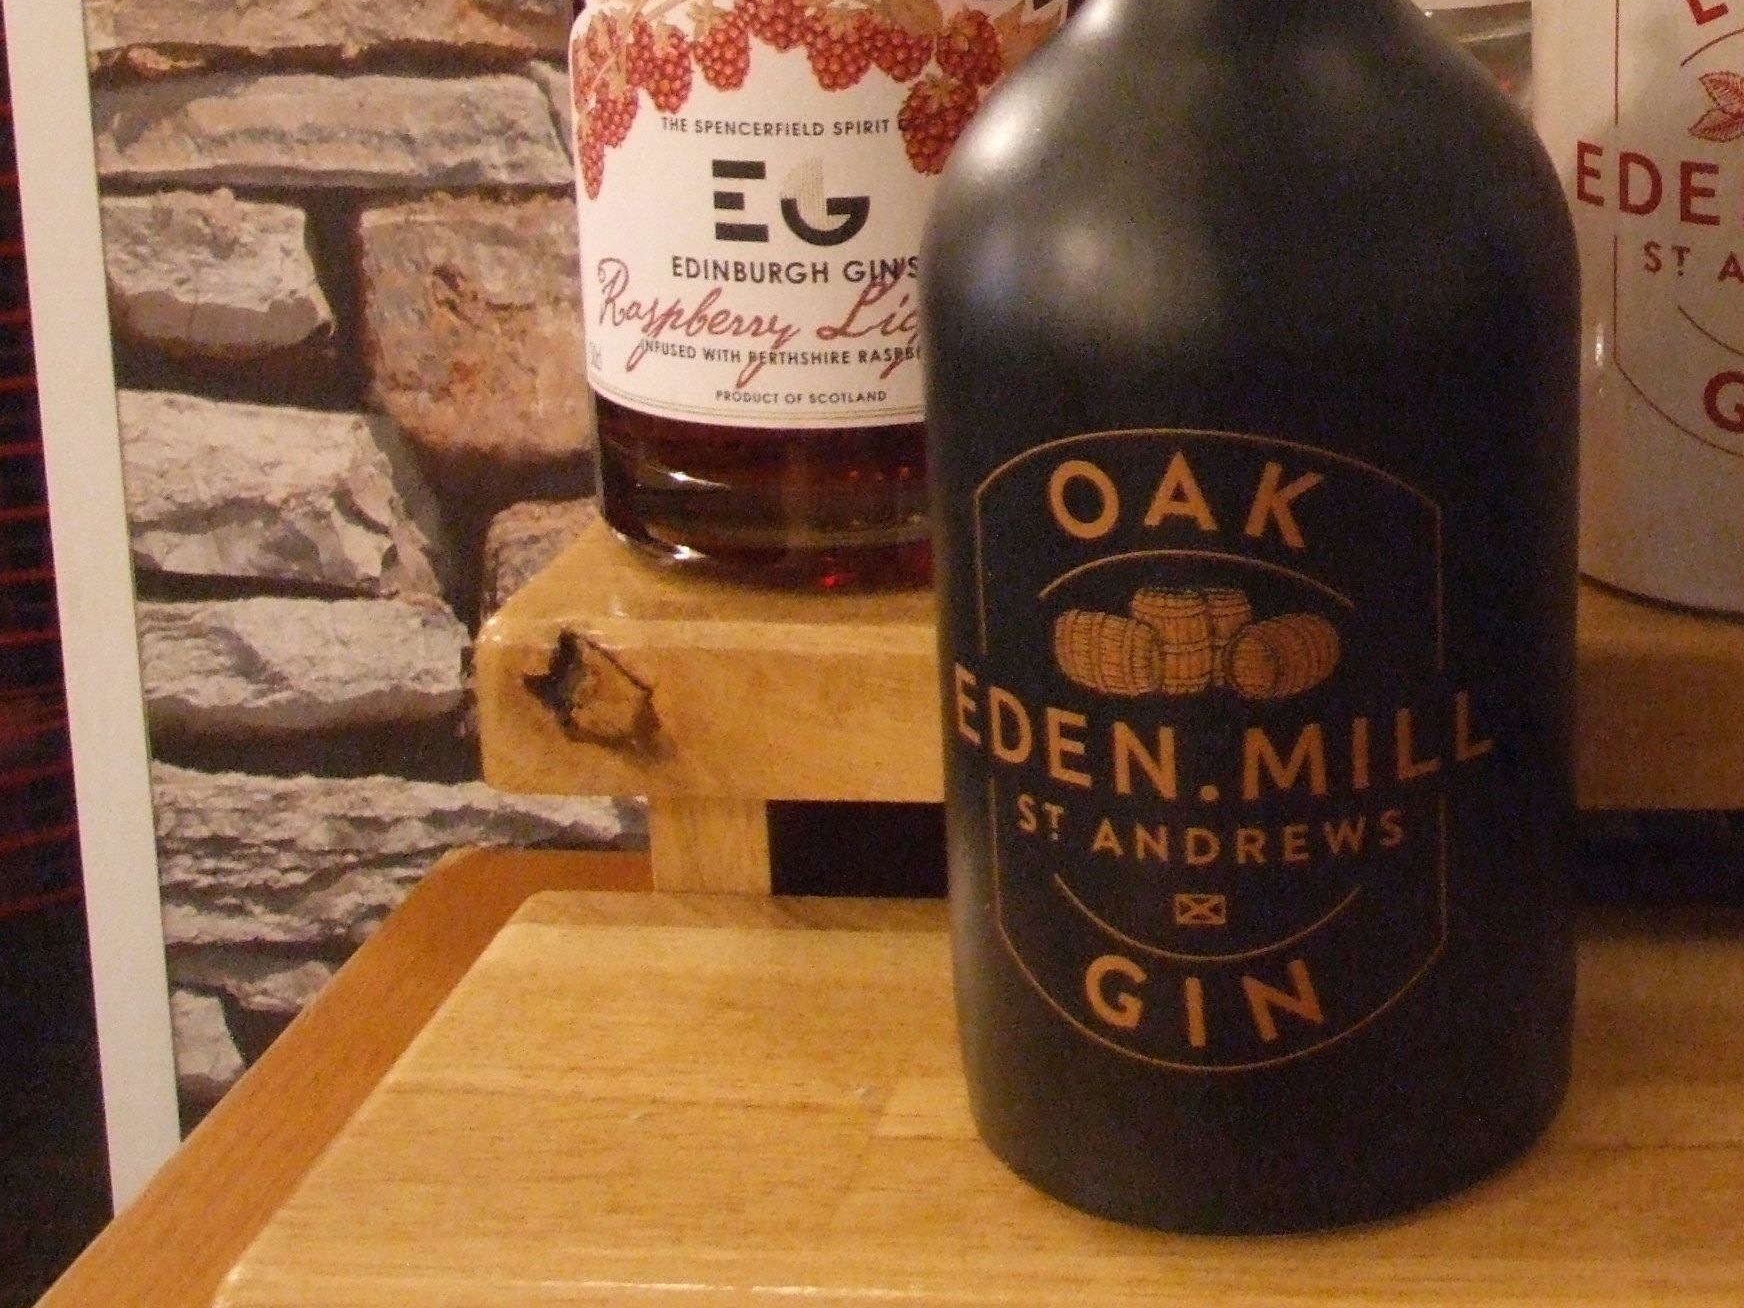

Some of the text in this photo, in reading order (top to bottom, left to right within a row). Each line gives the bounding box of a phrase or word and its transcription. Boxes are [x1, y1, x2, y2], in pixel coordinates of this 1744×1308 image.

[661, 116, 688, 133] THE
[695, 119, 825, 137] SPENCERFIELD
[833, 119, 890, 136] SPIRIT
[712, 157, 870, 247] EG
[672, 255, 829, 285] EDINBURGH
[641, 338, 696, 360] INFUSED
[703, 347, 742, 364] WITH
[749, 349, 850, 366] PERTHSHIRE
[716, 389, 887, 405] PRODUCT OF SCOTLAND
[1049, 451, 1325, 549] OAK
[1093, 810, 1405, 866] ANDREWS
[1085, 955, 1325, 1048] GIN
